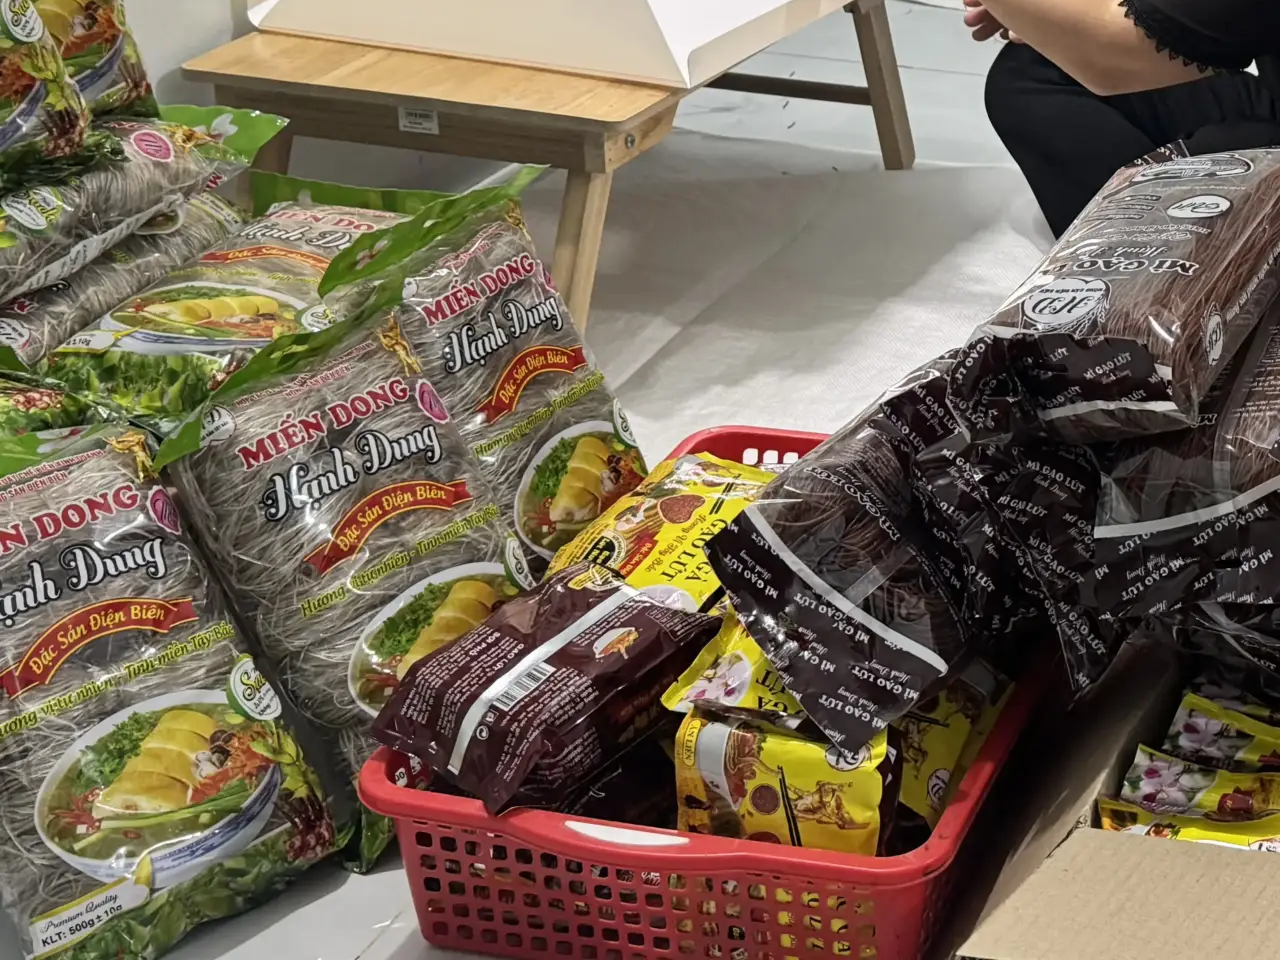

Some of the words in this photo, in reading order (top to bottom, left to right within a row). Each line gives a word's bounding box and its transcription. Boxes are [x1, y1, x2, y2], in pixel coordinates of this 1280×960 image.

[1150, 258, 1199, 275] MÌ
[422, 279, 480, 327] MIẾN
[478, 251, 535, 297] DONG
[443, 311, 509, 374] Hạnh
[501, 296, 563, 338] Dung
[513, 365, 528, 383] Sản
[547, 351, 568, 364] Biên
[236, 411, 327, 470] MIẾN
[328, 378, 410, 429] DONG
[262, 447, 358, 520] Hạnh
[356, 423, 442, 474] Dung
[1026, 459, 1042, 471] MÌ
[1042, 465, 1064, 483] GẠO
[1064, 476, 1086, 494] LỨT
[31, 483, 140, 541] DONG
[337, 525, 362, 552] Đặc
[357, 507, 382, 528] Sản
[382, 492, 413, 511] Điện
[416, 486, 447, 500] Biên
[660, 550, 697, 582] LỨT
[724, 554, 743, 574] LỨT
[744, 570, 765, 588] GẠO
[0, 559, 61, 628] ạnh
[59, 538, 168, 590] Dung
[765, 585, 779, 599] MÌ
[301, 584, 346, 618] Hương
[29, 645, 58, 674] Đặc
[57, 624, 88, 649] Sản
[89, 609, 126, 631] Điện
[130, 605, 165, 621] Biên
[852, 665, 876, 683] LỨT
[876, 676, 902, 695] GẠO
[818, 693, 843, 711] LỨT
[843, 703, 872, 722] GẠO
[0, 709, 38, 738] ương
[41, 911, 84, 933] Premium
[85, 894, 118, 914] Quality
[41, 931, 67, 947] KLT:
[69, 918, 95, 935] 500g
